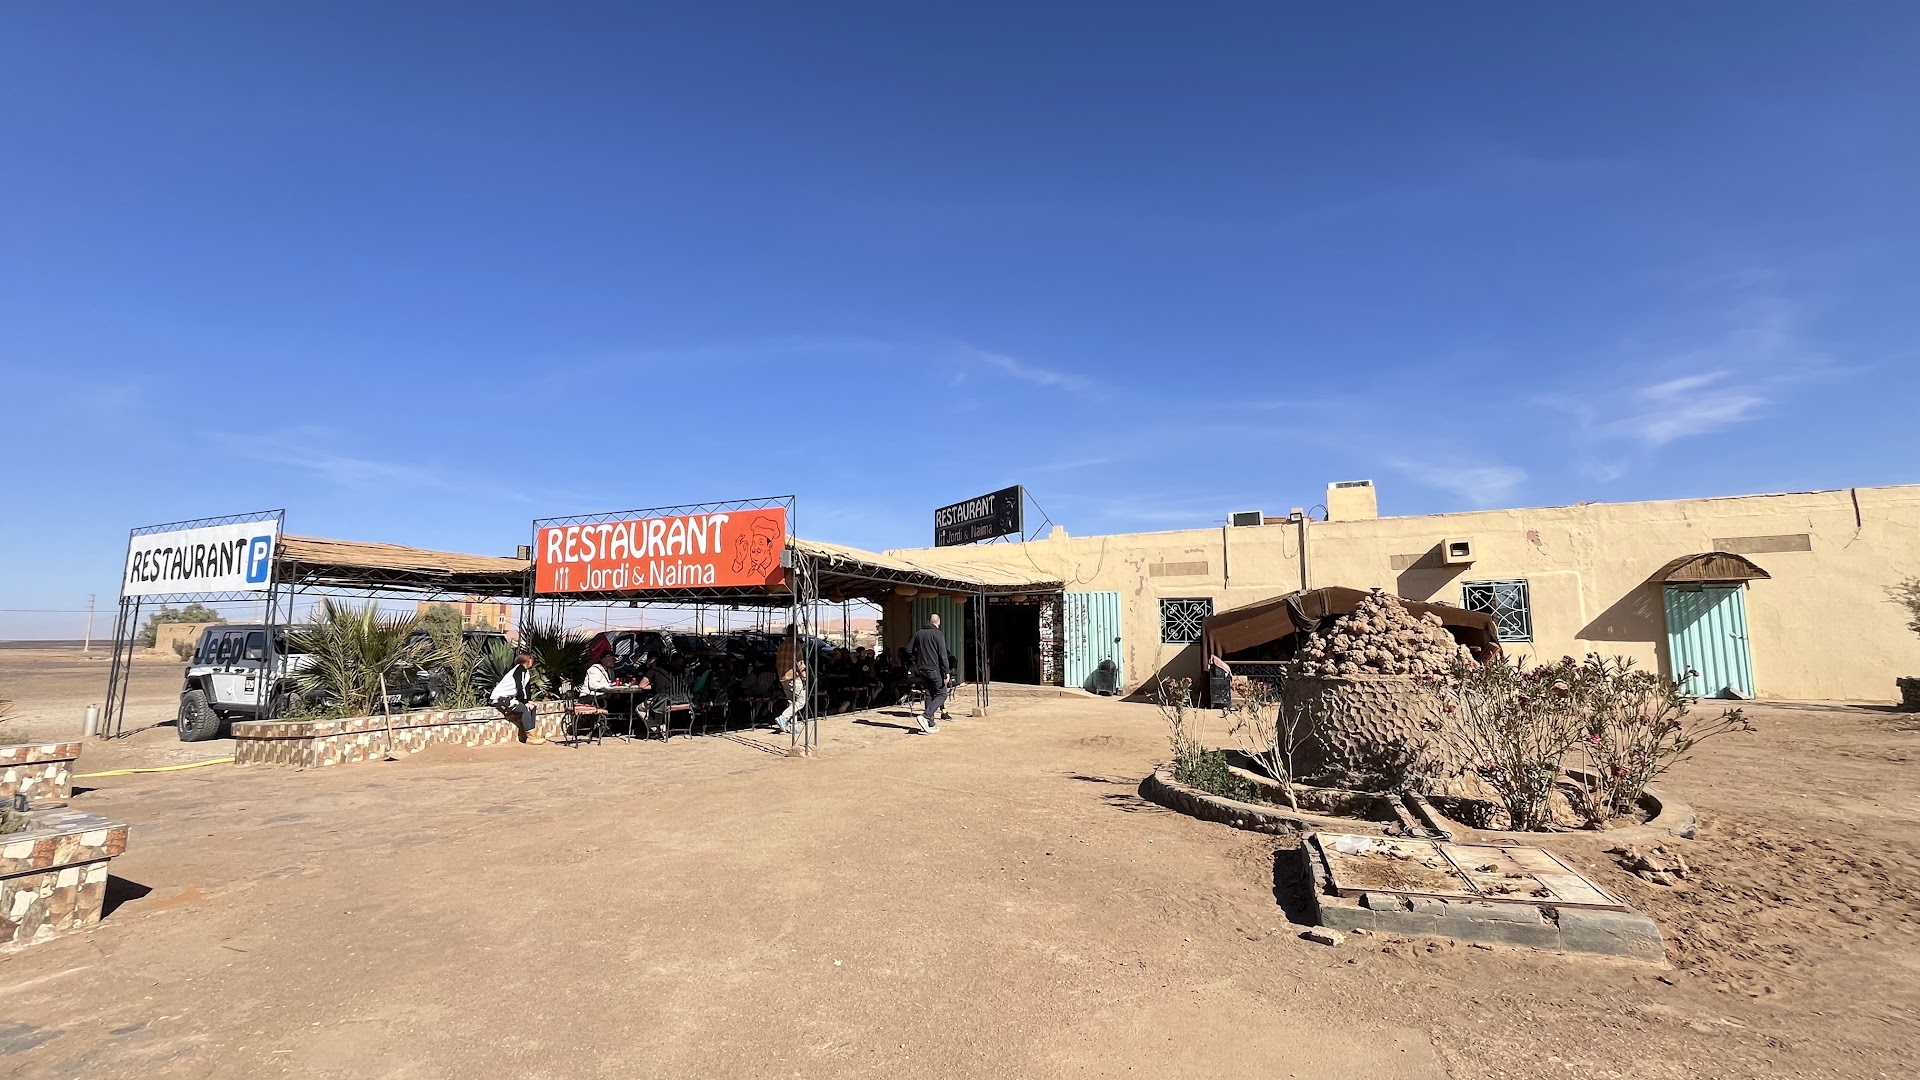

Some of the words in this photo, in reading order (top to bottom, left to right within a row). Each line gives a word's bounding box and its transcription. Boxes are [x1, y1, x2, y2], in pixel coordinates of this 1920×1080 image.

[936, 495, 995, 528] RESTAURANT
[546, 514, 729, 564] RESTAURANT
[946, 528, 963, 543] Jordi
[970, 524, 993, 538] Naima
[130, 538, 247, 583] RESTAURANT
[251, 541, 267, 577] P
[580, 563, 629, 590] Jordi
[632, 566, 645, 585] &
[649, 560, 715, 587] Naima
[193, 631, 244, 672] Jeep
